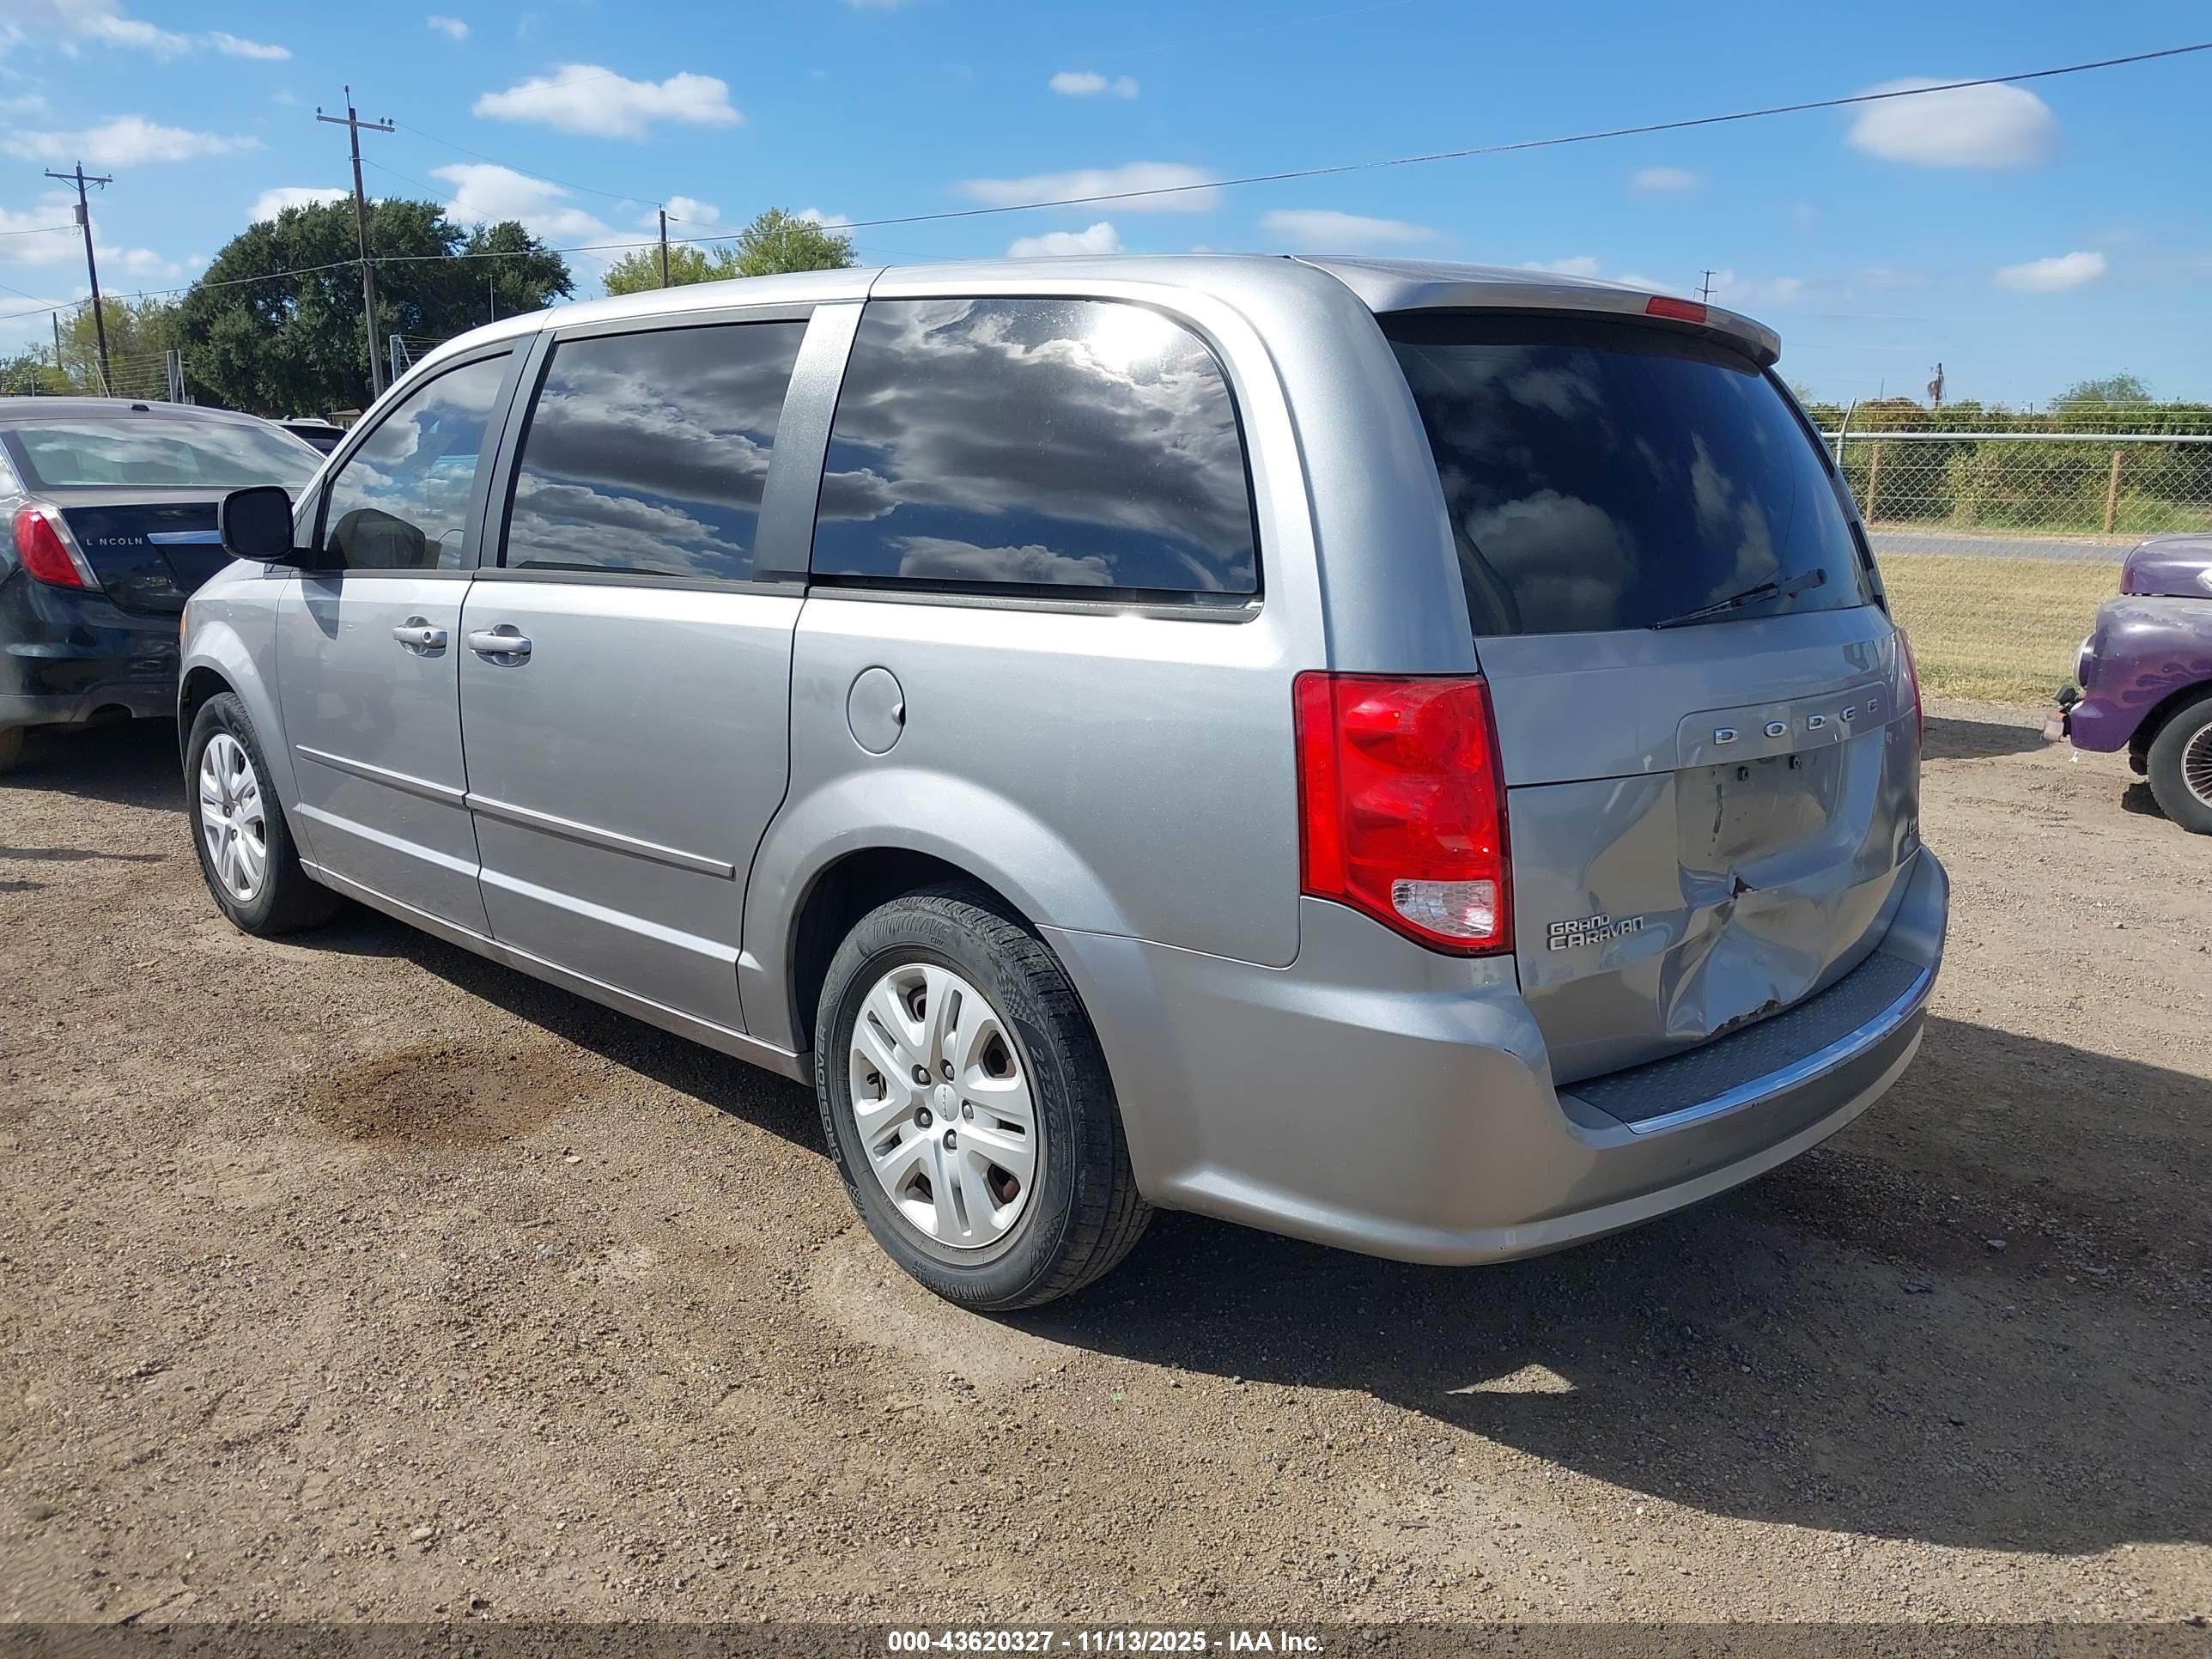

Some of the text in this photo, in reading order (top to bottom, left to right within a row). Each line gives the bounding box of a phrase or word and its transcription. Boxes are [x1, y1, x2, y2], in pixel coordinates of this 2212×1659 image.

[86, 537, 143, 547] LNCOLN
[1714, 698, 1878, 745] DODGE
[1547, 915, 1644, 951] CARAVAN
[1548, 913, 1610, 936] GRAND
[817, 1024, 842, 1164] CROSSOVER
